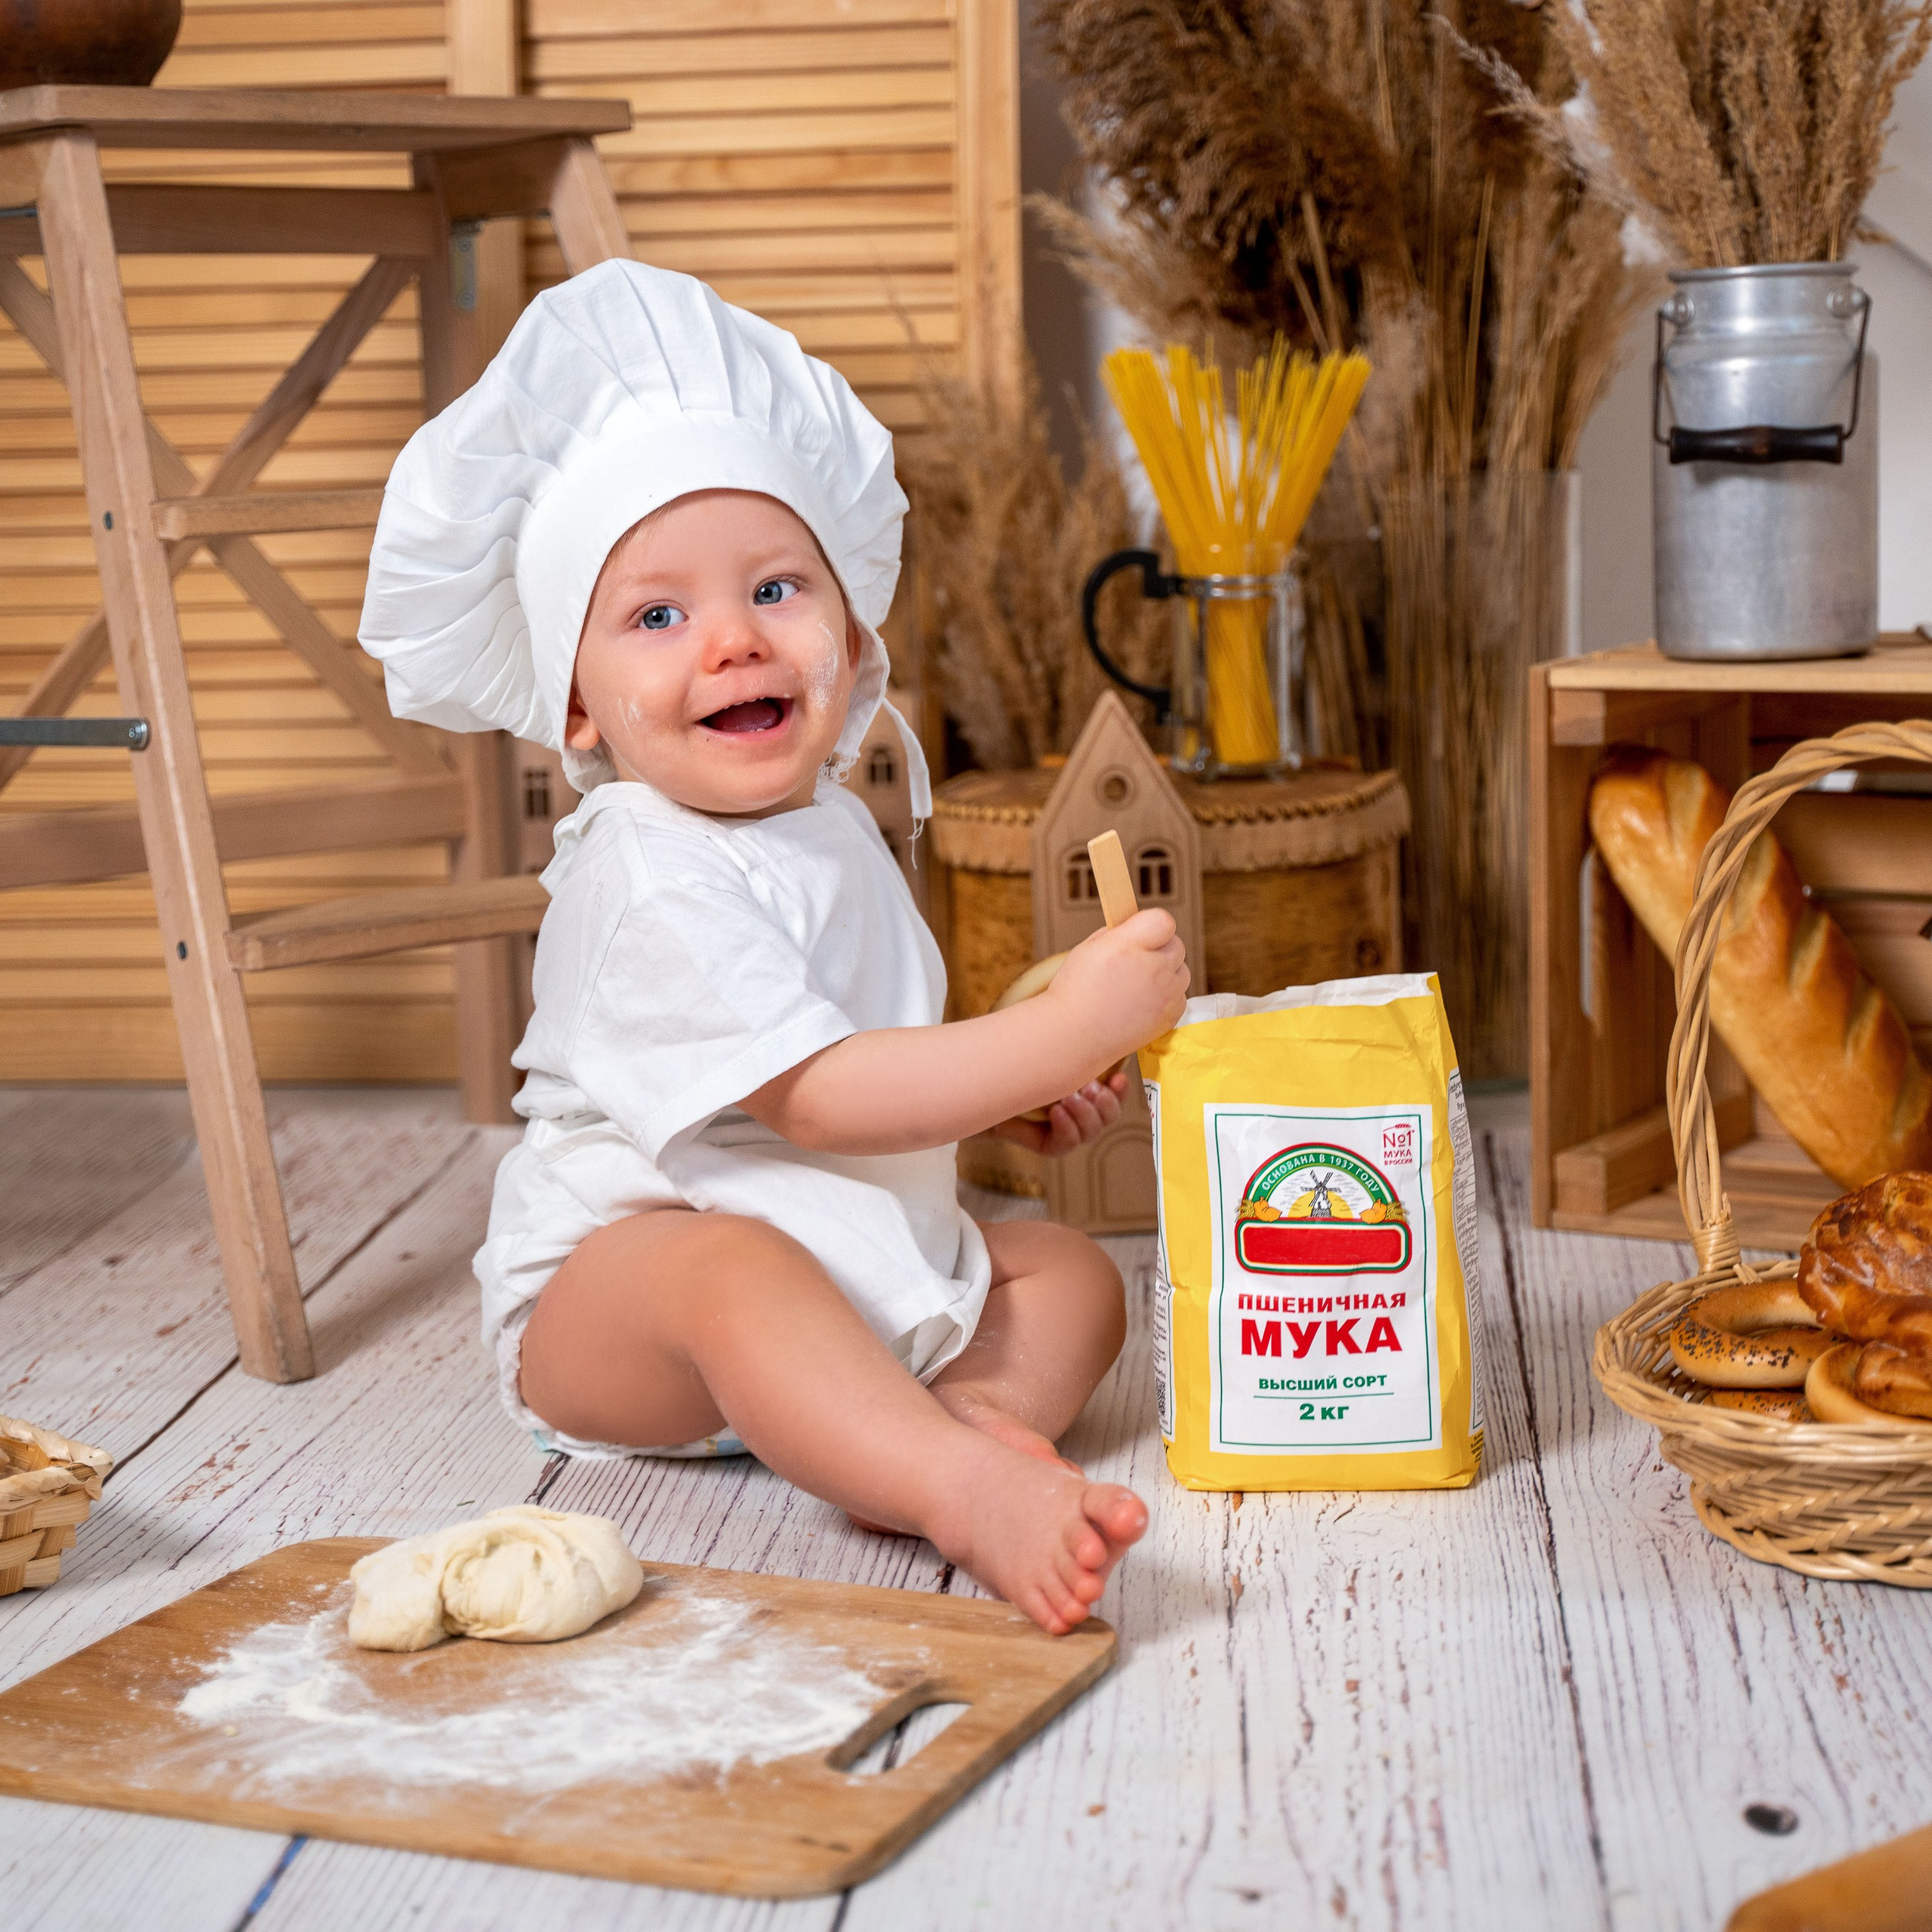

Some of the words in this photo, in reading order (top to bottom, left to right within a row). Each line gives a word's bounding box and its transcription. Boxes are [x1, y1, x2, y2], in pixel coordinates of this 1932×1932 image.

[1384, 1149, 1411, 1158] МУКА
[1262, 1154, 1315, 1190] ОСНОВАНА
[1319, 1154, 1325, 1162] В
[1331, 1155, 1354, 1171] 1937
[1355, 1168, 1380, 1192] ГОДУ
[1238, 1293, 1406, 1313] ПШЕНИЧНАЯ
[1241, 1316, 1402, 1358] МУКА
[1259, 1375, 1337, 1390] ВЫСШИЙ
[1343, 1375, 1387, 1388] СОРТ
[1300, 1403, 1315, 1420] 2
